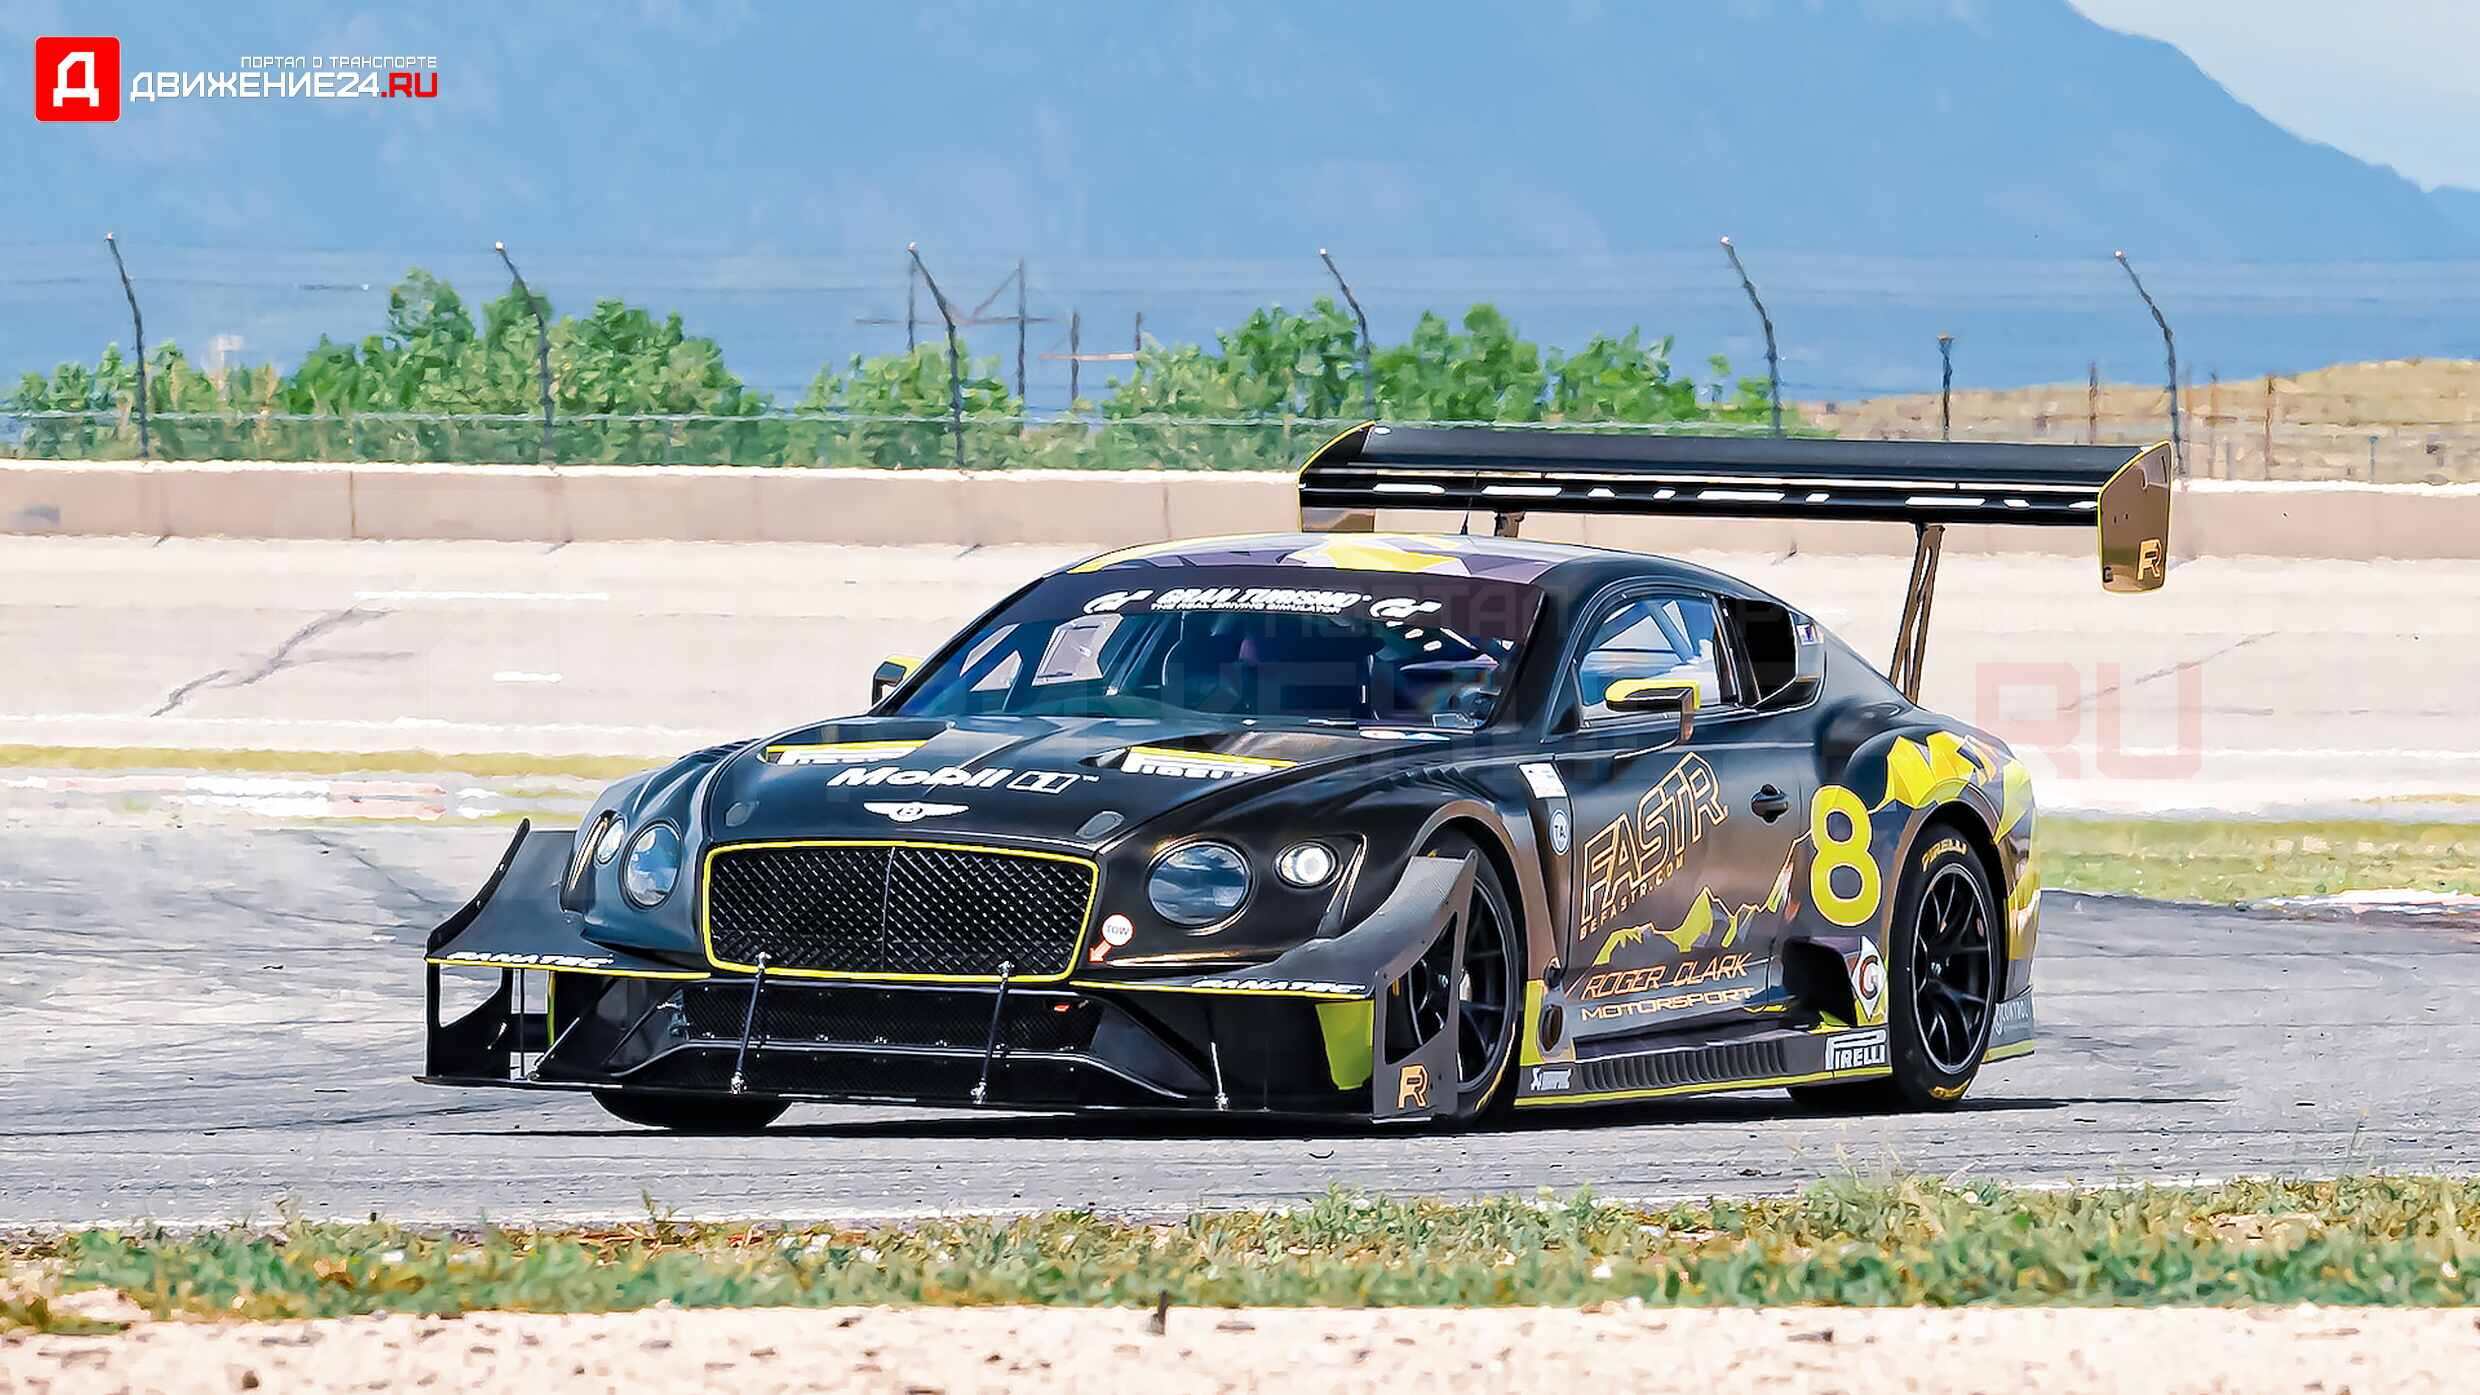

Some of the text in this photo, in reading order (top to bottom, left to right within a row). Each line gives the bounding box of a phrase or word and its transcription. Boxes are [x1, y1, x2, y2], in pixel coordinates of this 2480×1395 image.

[826, 766, 1001, 788] Mobil
[1580, 751, 1729, 926] FASTR
[1810, 785, 1882, 927] 8
[1581, 953, 1752, 1000] ROGER CLARK
[1582, 988, 1755, 1021] MOTORSPORT
[1825, 1029, 1887, 1070] PIRELLI
[1397, 1064, 1431, 1109] R
